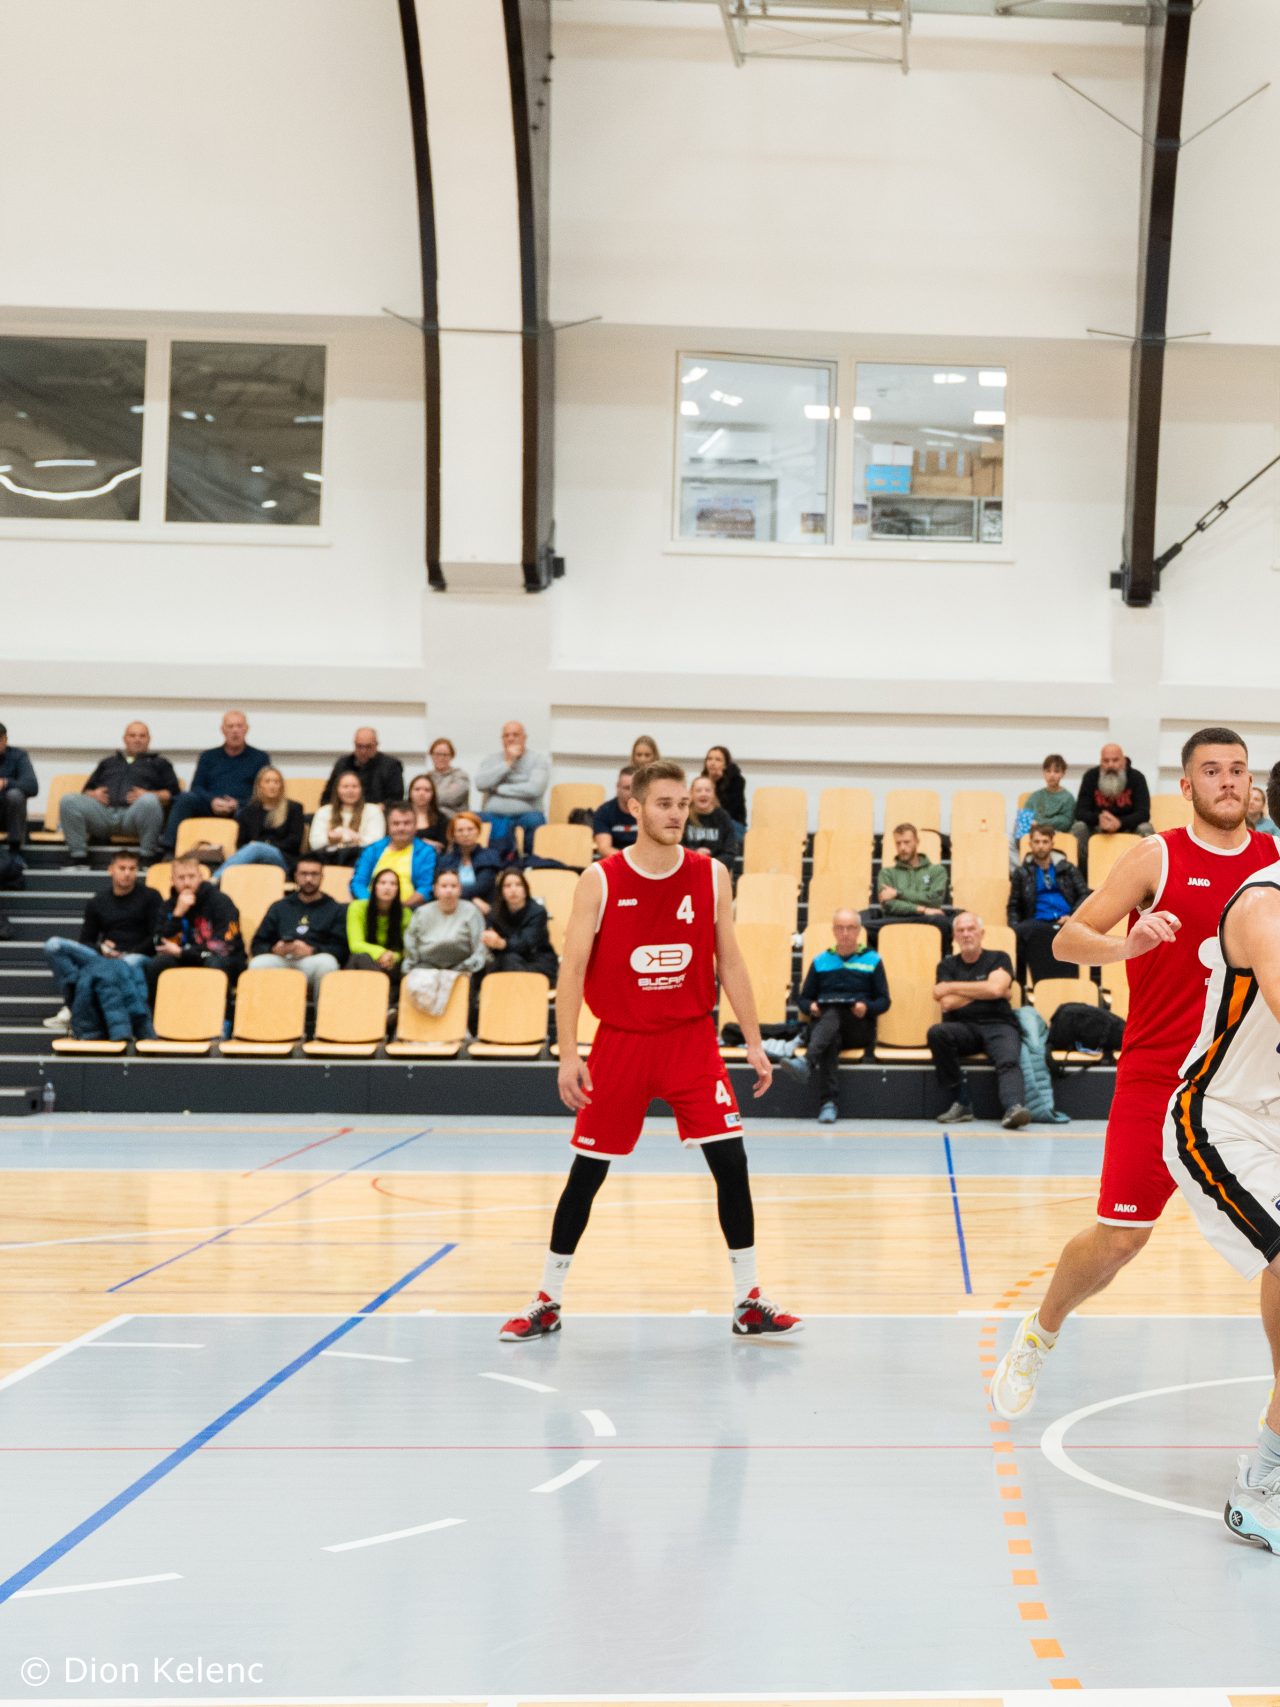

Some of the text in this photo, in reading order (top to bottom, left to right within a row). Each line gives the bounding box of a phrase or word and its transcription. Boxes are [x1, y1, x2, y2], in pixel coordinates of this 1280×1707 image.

[1187, 877, 1211, 887] JAKO
[617, 898, 638, 907] JAKO
[676, 894, 695, 925] 4
[715, 1080, 732, 1107] 4
[1113, 1203, 1138, 1213] JAKO
